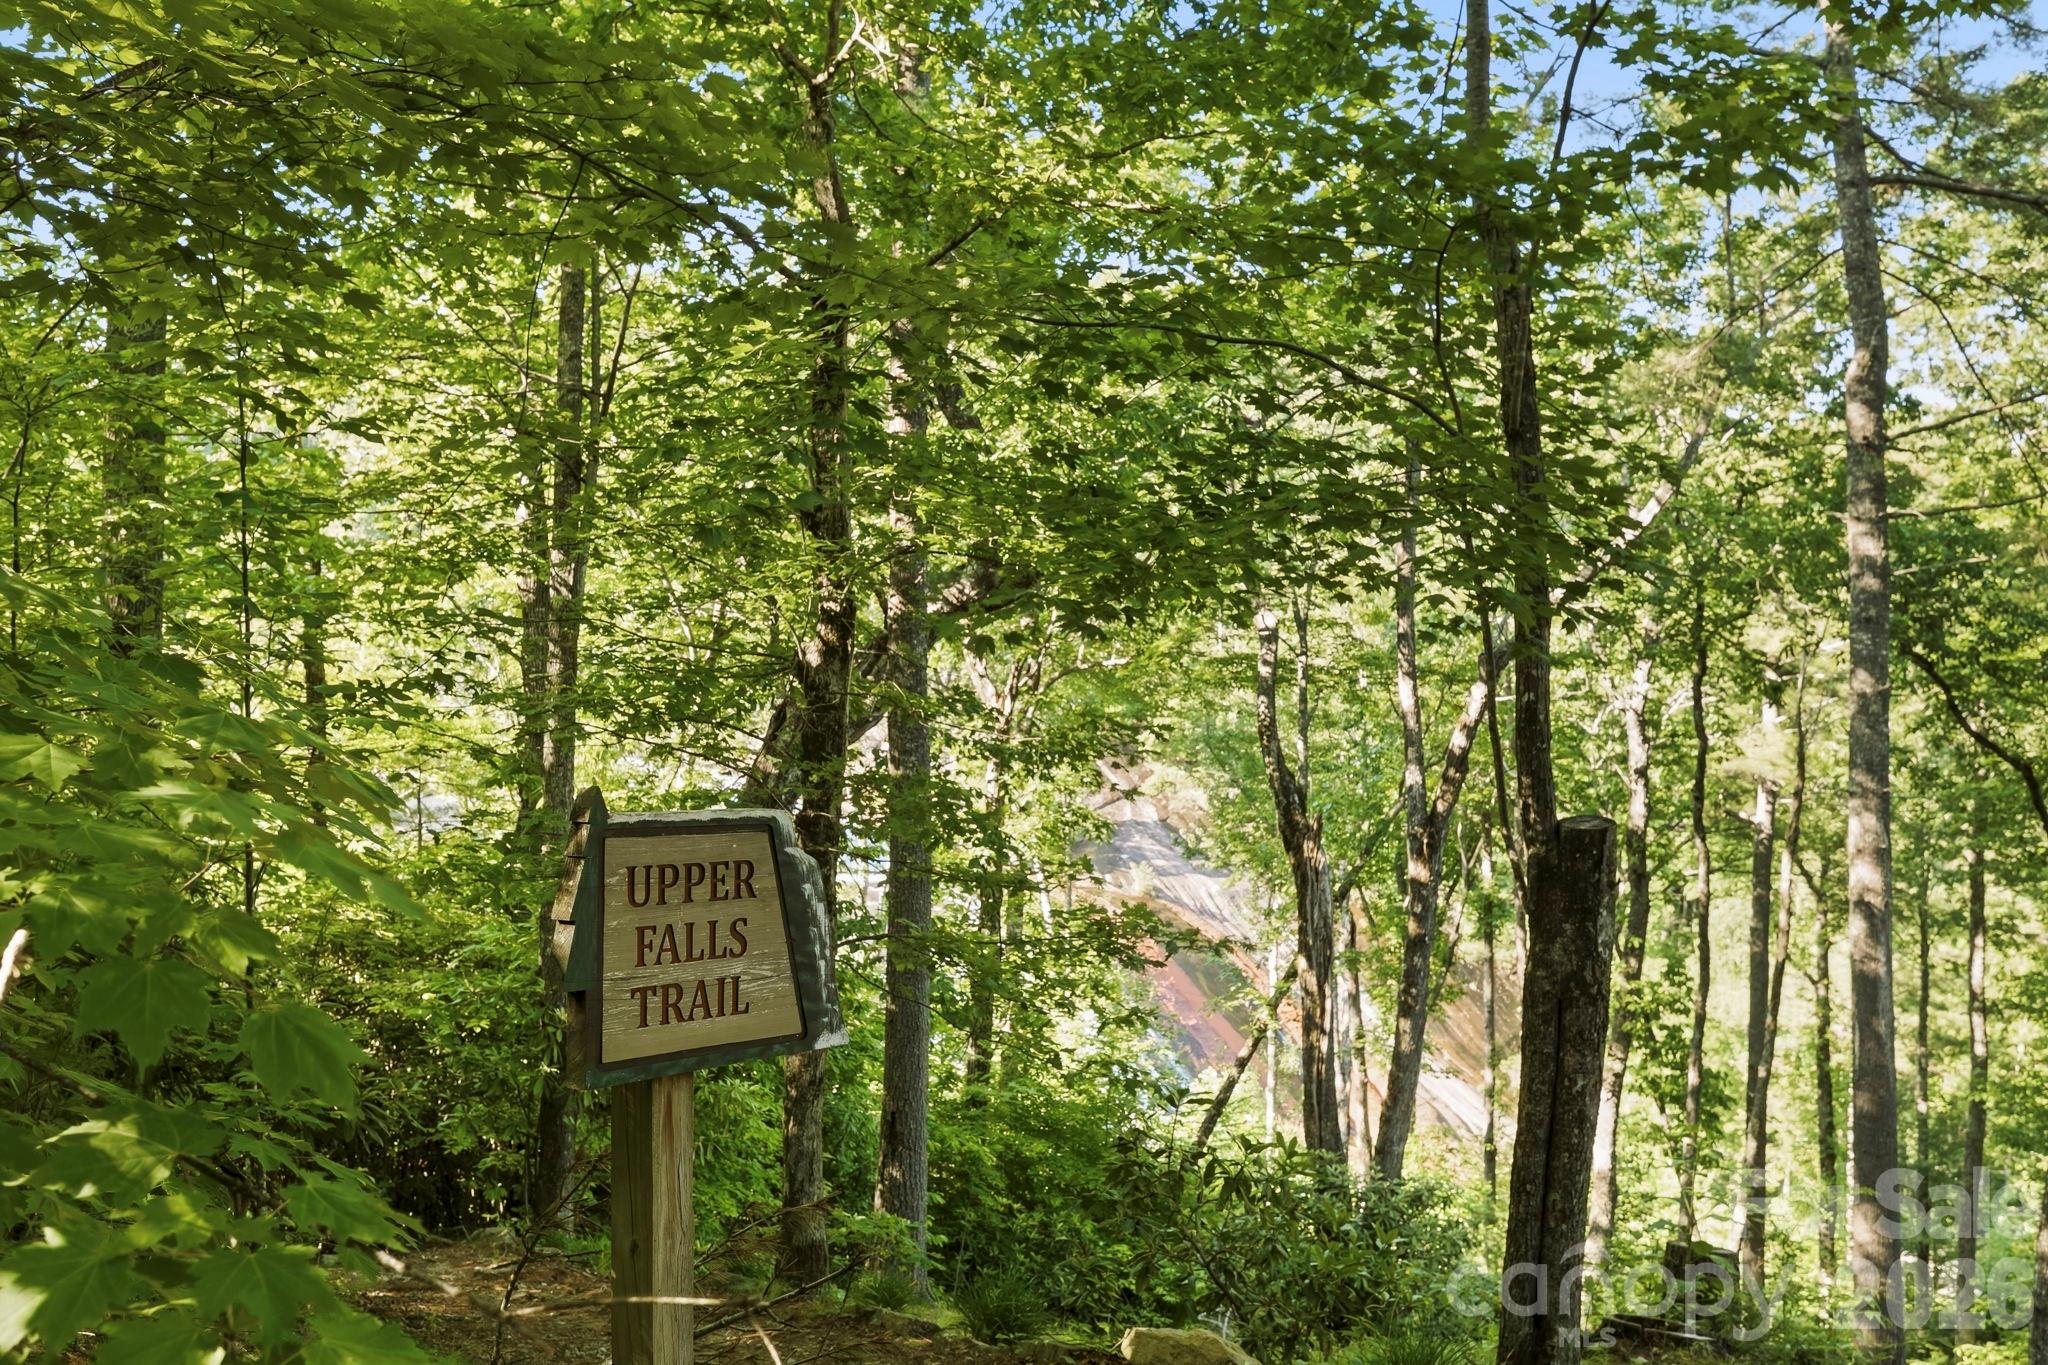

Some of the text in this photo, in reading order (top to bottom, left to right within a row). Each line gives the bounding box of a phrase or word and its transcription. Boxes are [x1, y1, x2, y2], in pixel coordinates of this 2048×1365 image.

[625, 859, 757, 908] UPPER
[634, 917, 748, 968] FALLS
[630, 975, 750, 1029] TRAIL
